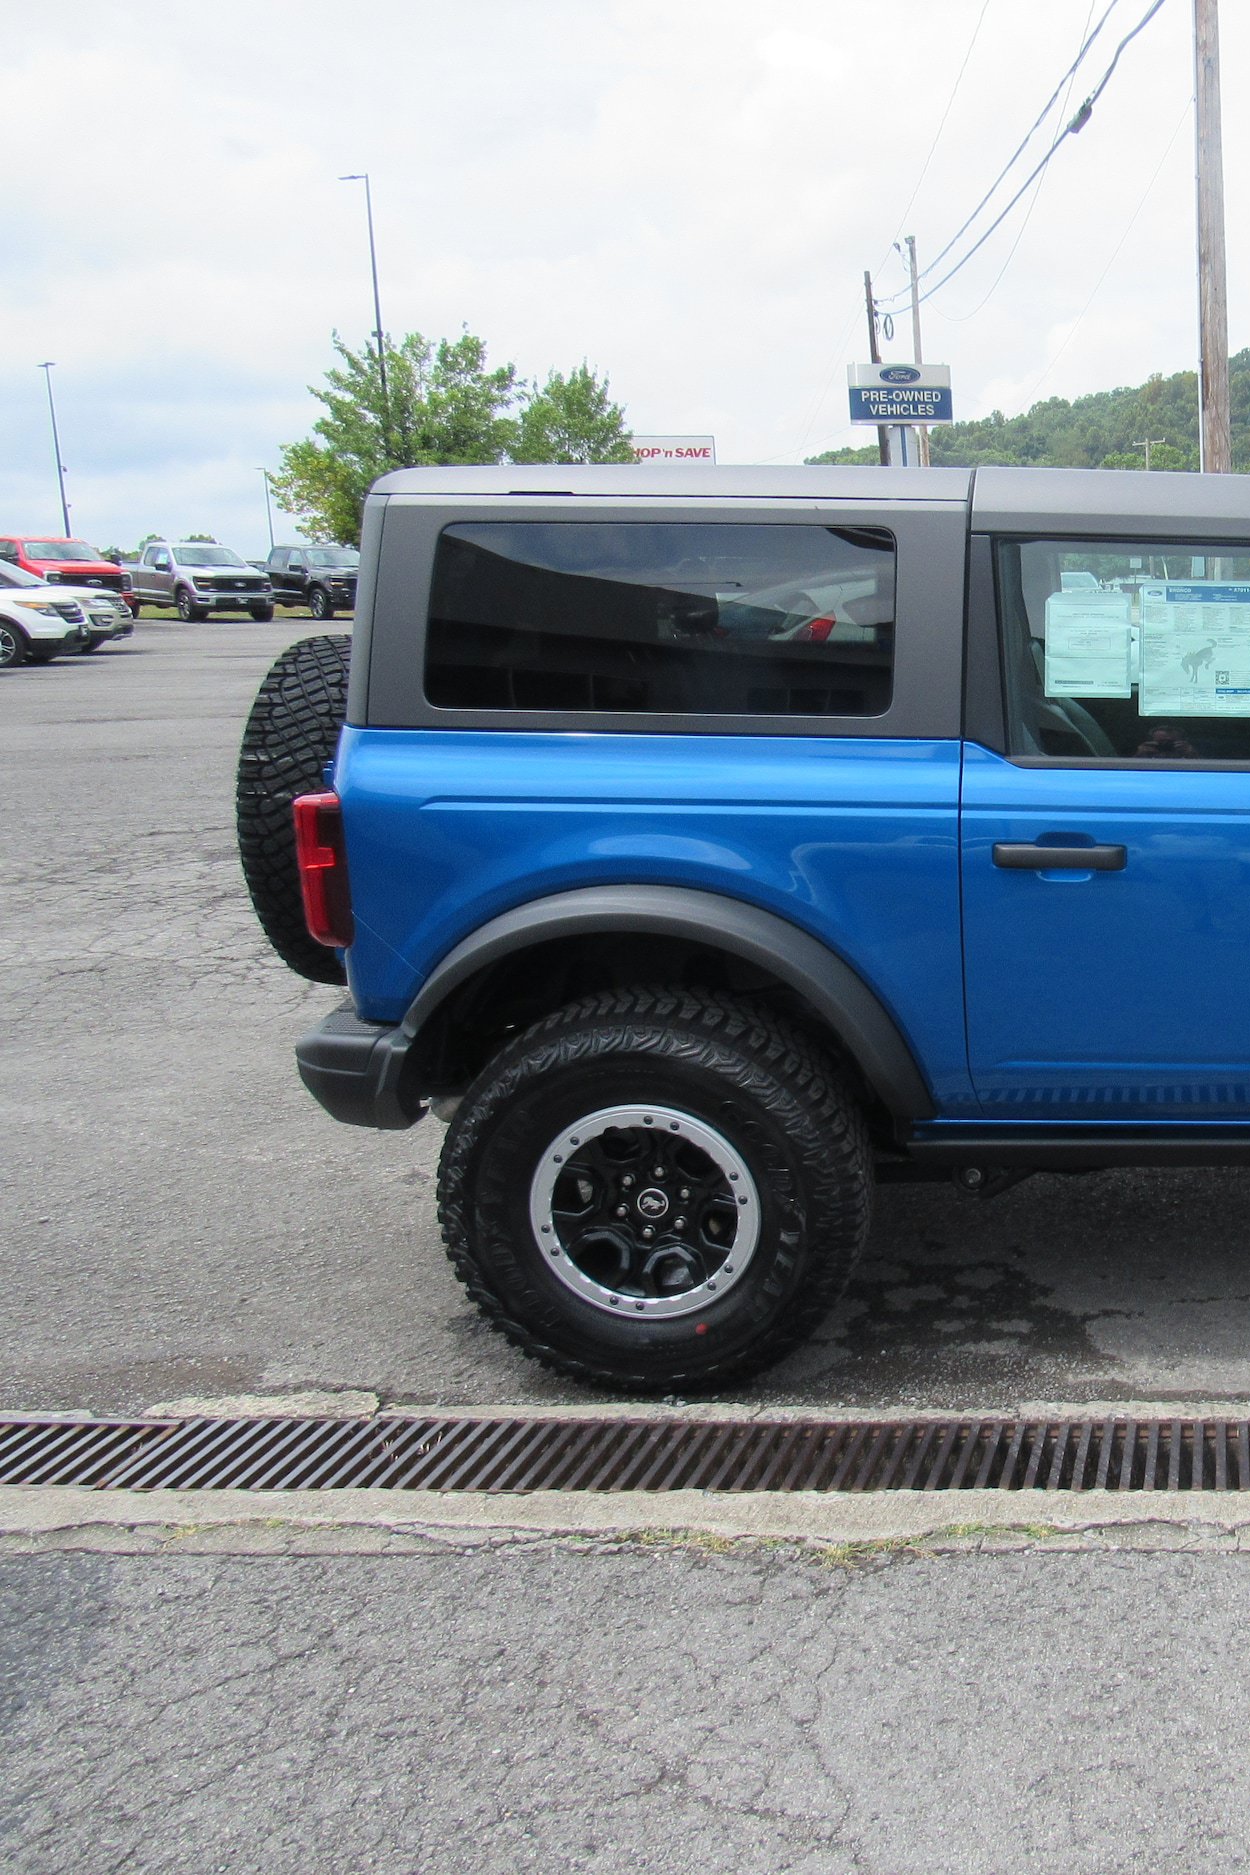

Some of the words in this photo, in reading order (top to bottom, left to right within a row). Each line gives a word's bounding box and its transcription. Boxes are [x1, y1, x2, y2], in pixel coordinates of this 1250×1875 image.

[861, 390, 941, 402] PRE-OWNED
[870, 404, 935, 415] VEHICLES
[633, 448, 661, 458] HOP
[675, 448, 711, 458] SAVE
